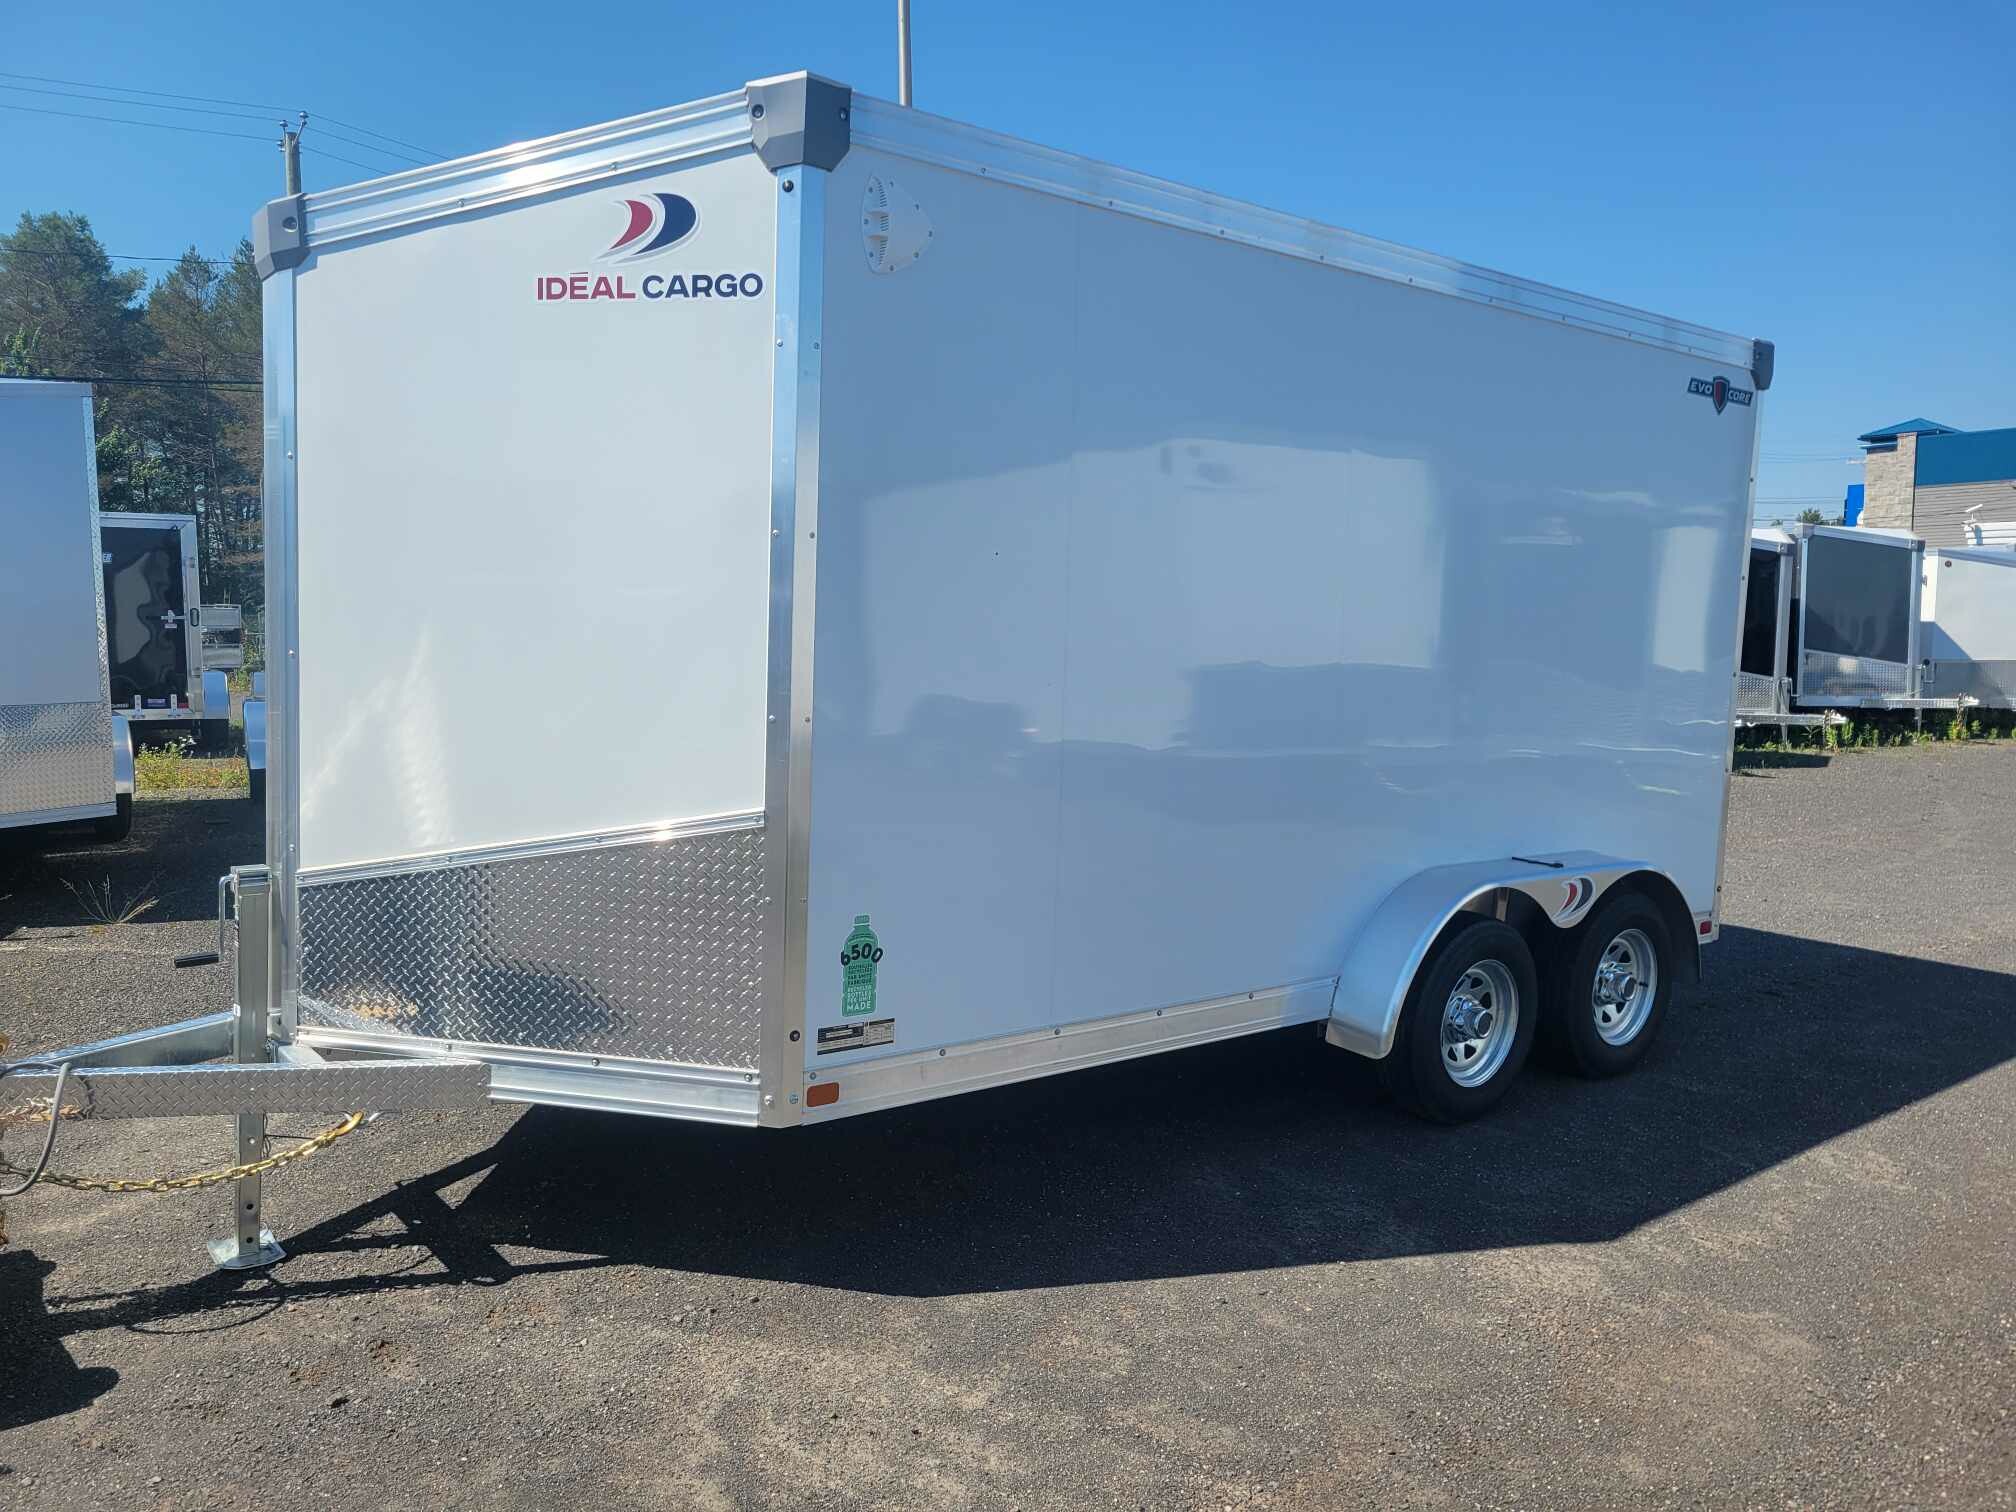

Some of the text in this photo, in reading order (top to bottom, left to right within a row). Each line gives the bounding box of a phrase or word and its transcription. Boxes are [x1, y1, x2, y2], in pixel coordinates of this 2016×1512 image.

[642, 272, 763, 299] CARGO
[1690, 380, 1751, 403] EVO CORE
[840, 942, 883, 967] 6500
[847, 1001, 871, 1011] MADE
